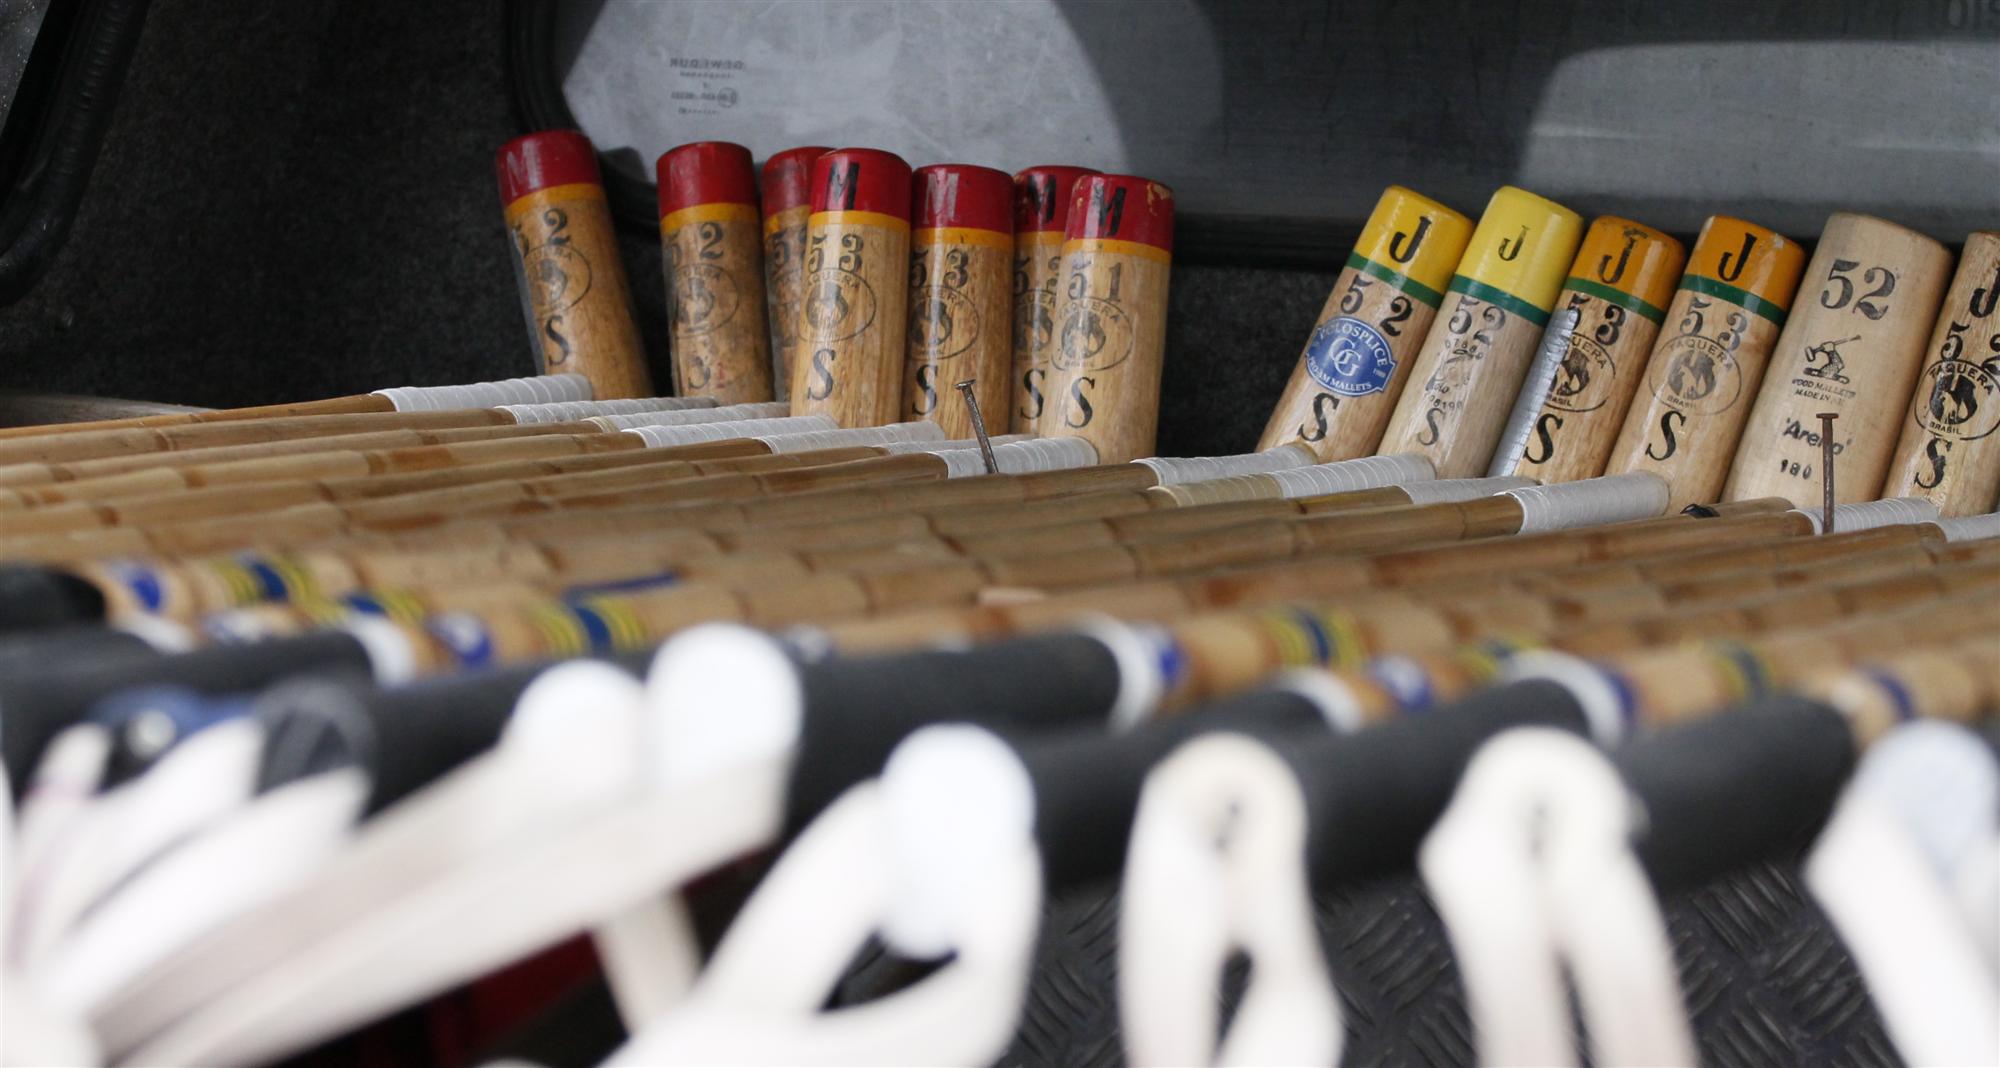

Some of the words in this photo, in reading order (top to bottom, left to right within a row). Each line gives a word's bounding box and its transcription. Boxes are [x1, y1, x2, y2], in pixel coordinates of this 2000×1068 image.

[506, 138, 544, 197] M
[825, 161, 861, 212] M
[923, 171, 960, 225] M
[807, 232, 865, 274] 53
[1388, 216, 1432, 264] J
[1498, 224, 1530, 262] J
[1598, 236, 1637, 284] J
[1717, 233, 1758, 282] J
[911, 247, 970, 289] 53
[1068, 254, 1122, 302] 51
[1820, 259, 1896, 320] 52
[1969, 266, 2000, 319] J
[1340, 273, 1414, 337] 52
[1448, 295, 1507, 347] 52
[1566, 293, 1626, 346] 53
[1679, 297, 1748, 352] 53
[545, 314, 570, 366] S
[1571, 336, 1609, 370] UERA
[807, 349, 836, 400] S
[912, 364, 938, 416] S
[1020, 368, 1046, 420] S
[1330, 377, 1373, 392] MALLETS
[1928, 364, 1995, 397] TAQUERA
[1065, 376, 1095, 429] S
[1297, 392, 1340, 442] S
[1417, 407, 1446, 447] S
[1523, 413, 1564, 464] S
[1644, 410, 1686, 461] S
[1913, 437, 1953, 489] S
